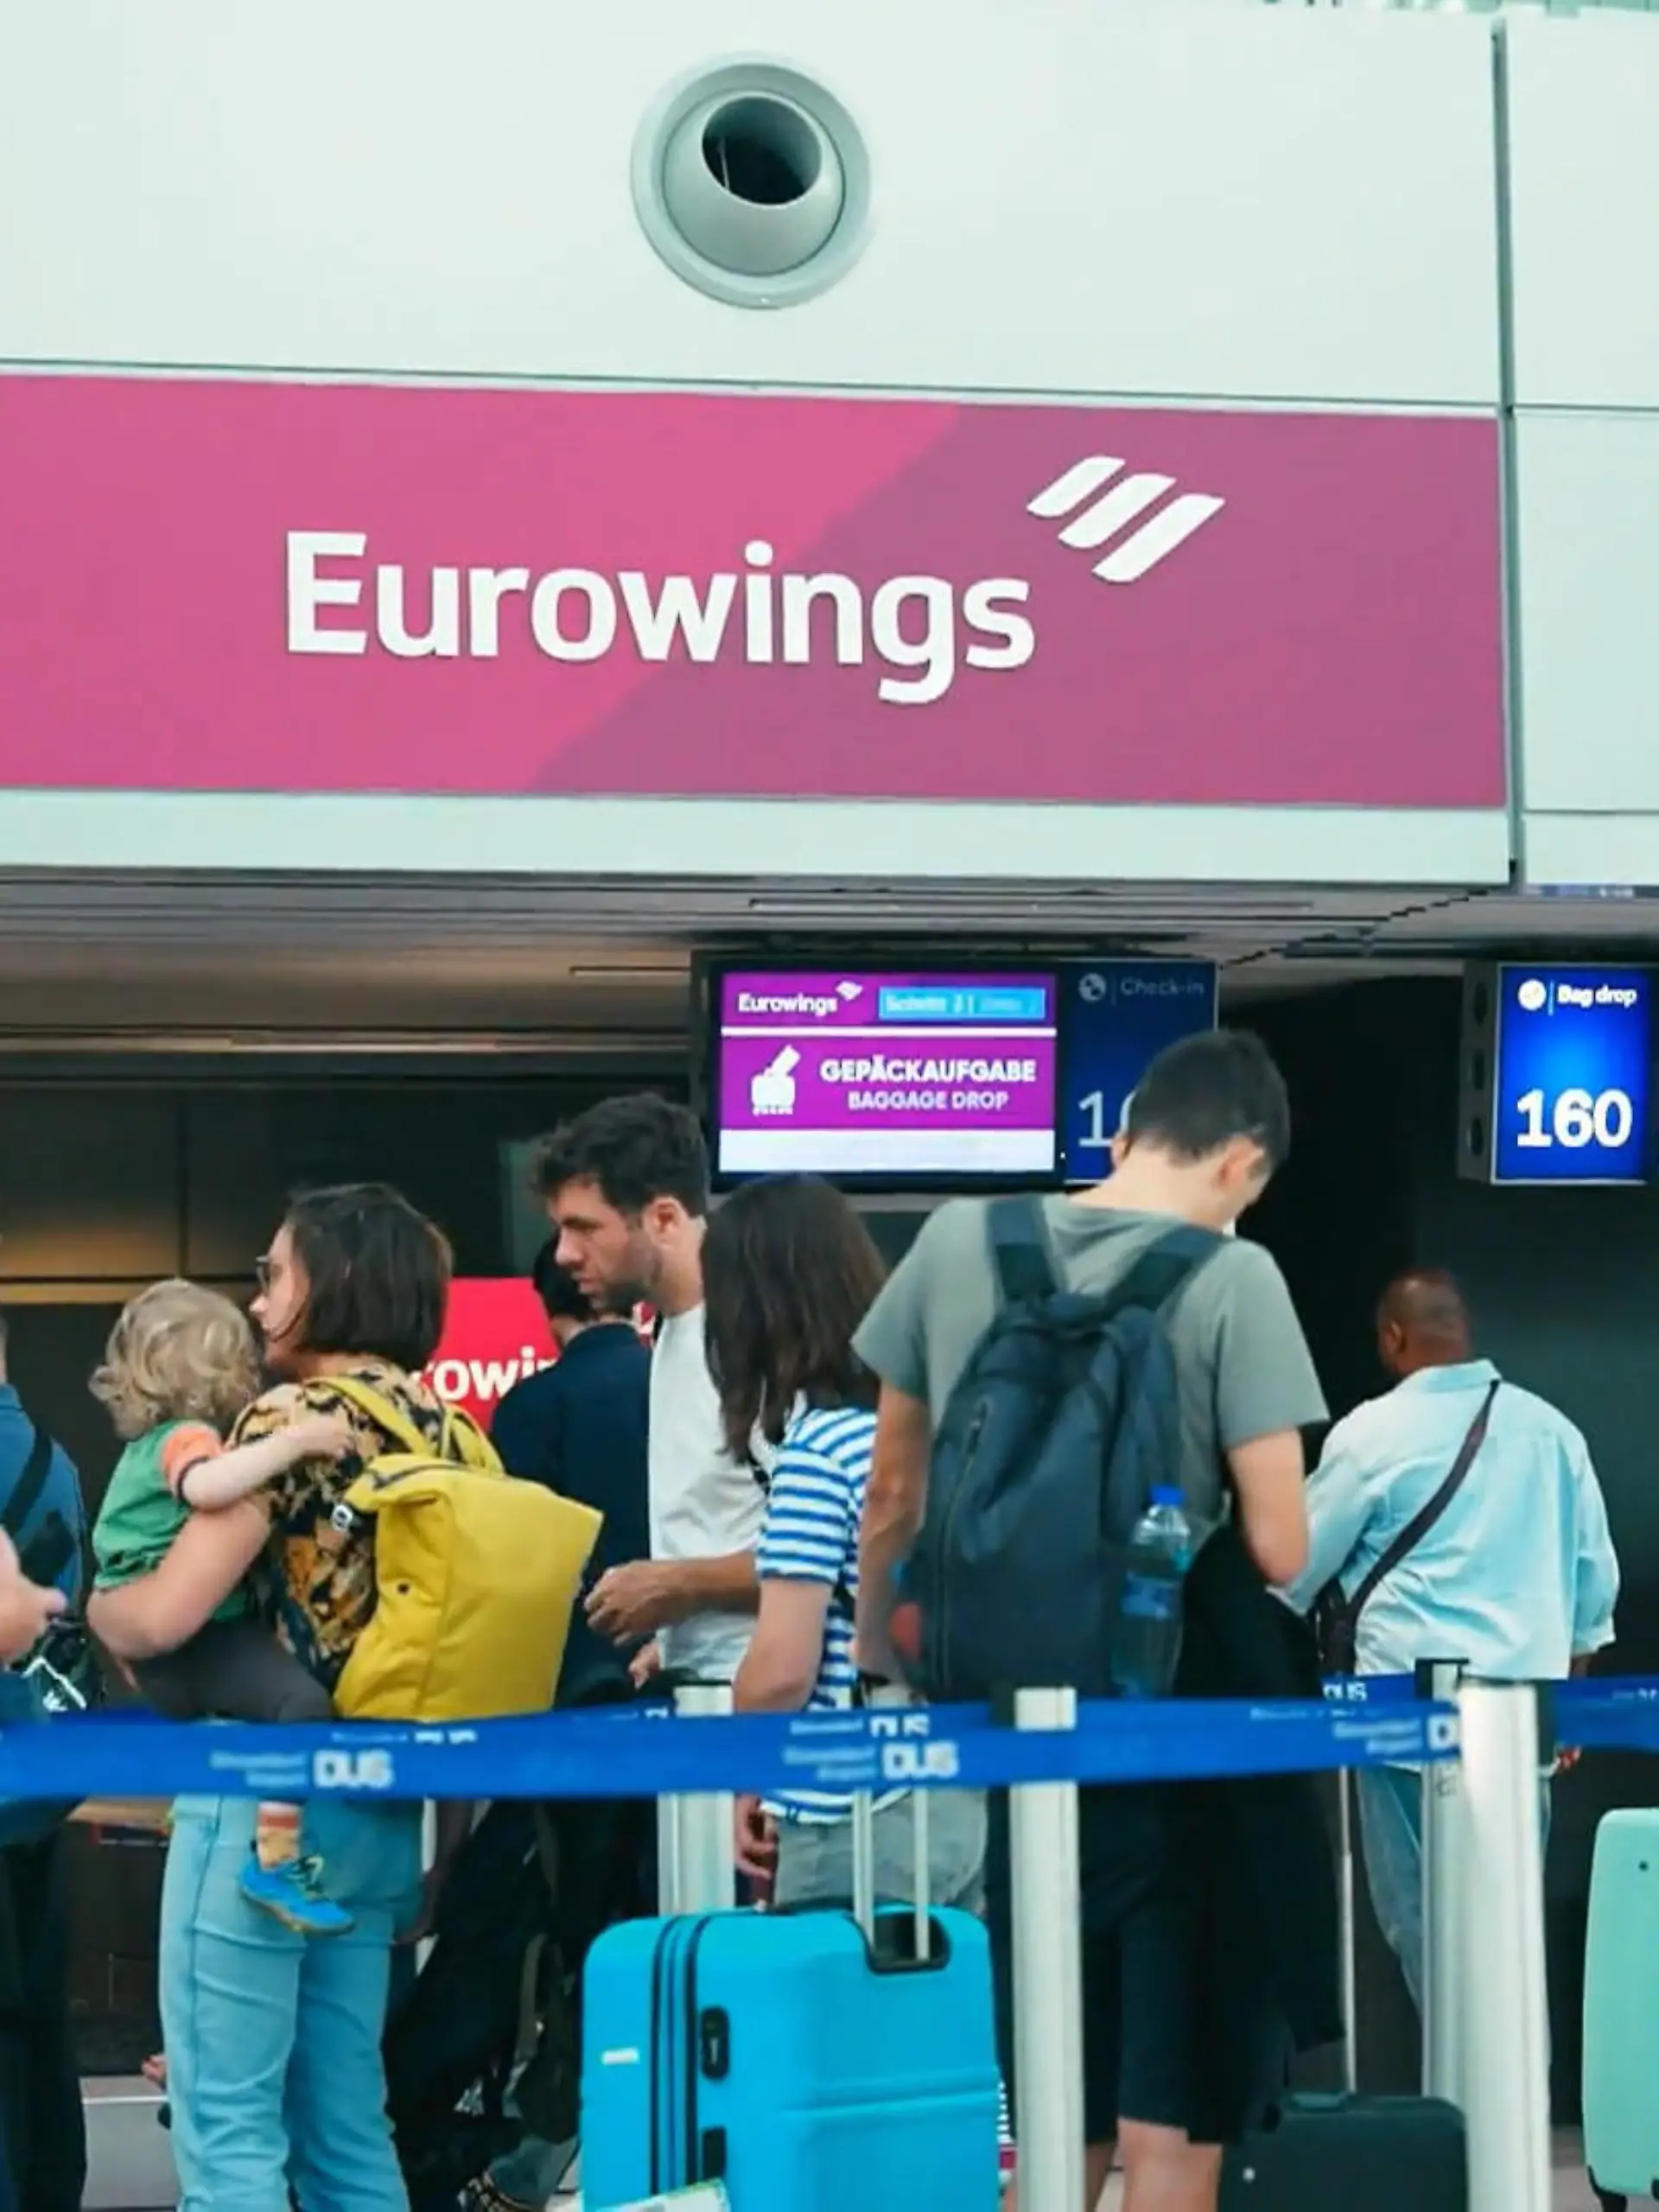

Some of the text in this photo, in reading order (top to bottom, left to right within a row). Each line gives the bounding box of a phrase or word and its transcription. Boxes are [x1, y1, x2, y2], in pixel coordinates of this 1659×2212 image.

[285, 530, 1036, 705] Eurowings
[1120, 976, 1206, 996] Check-in
[1557, 983, 1637, 1008] Bag drop
[738, 993, 838, 1017] Eurowings
[820, 1054, 1037, 1083] GEPÄCKAUFGABE
[848, 1091, 1009, 1110] BAGGAGE DROP
[1516, 1088, 1633, 1147] 160
